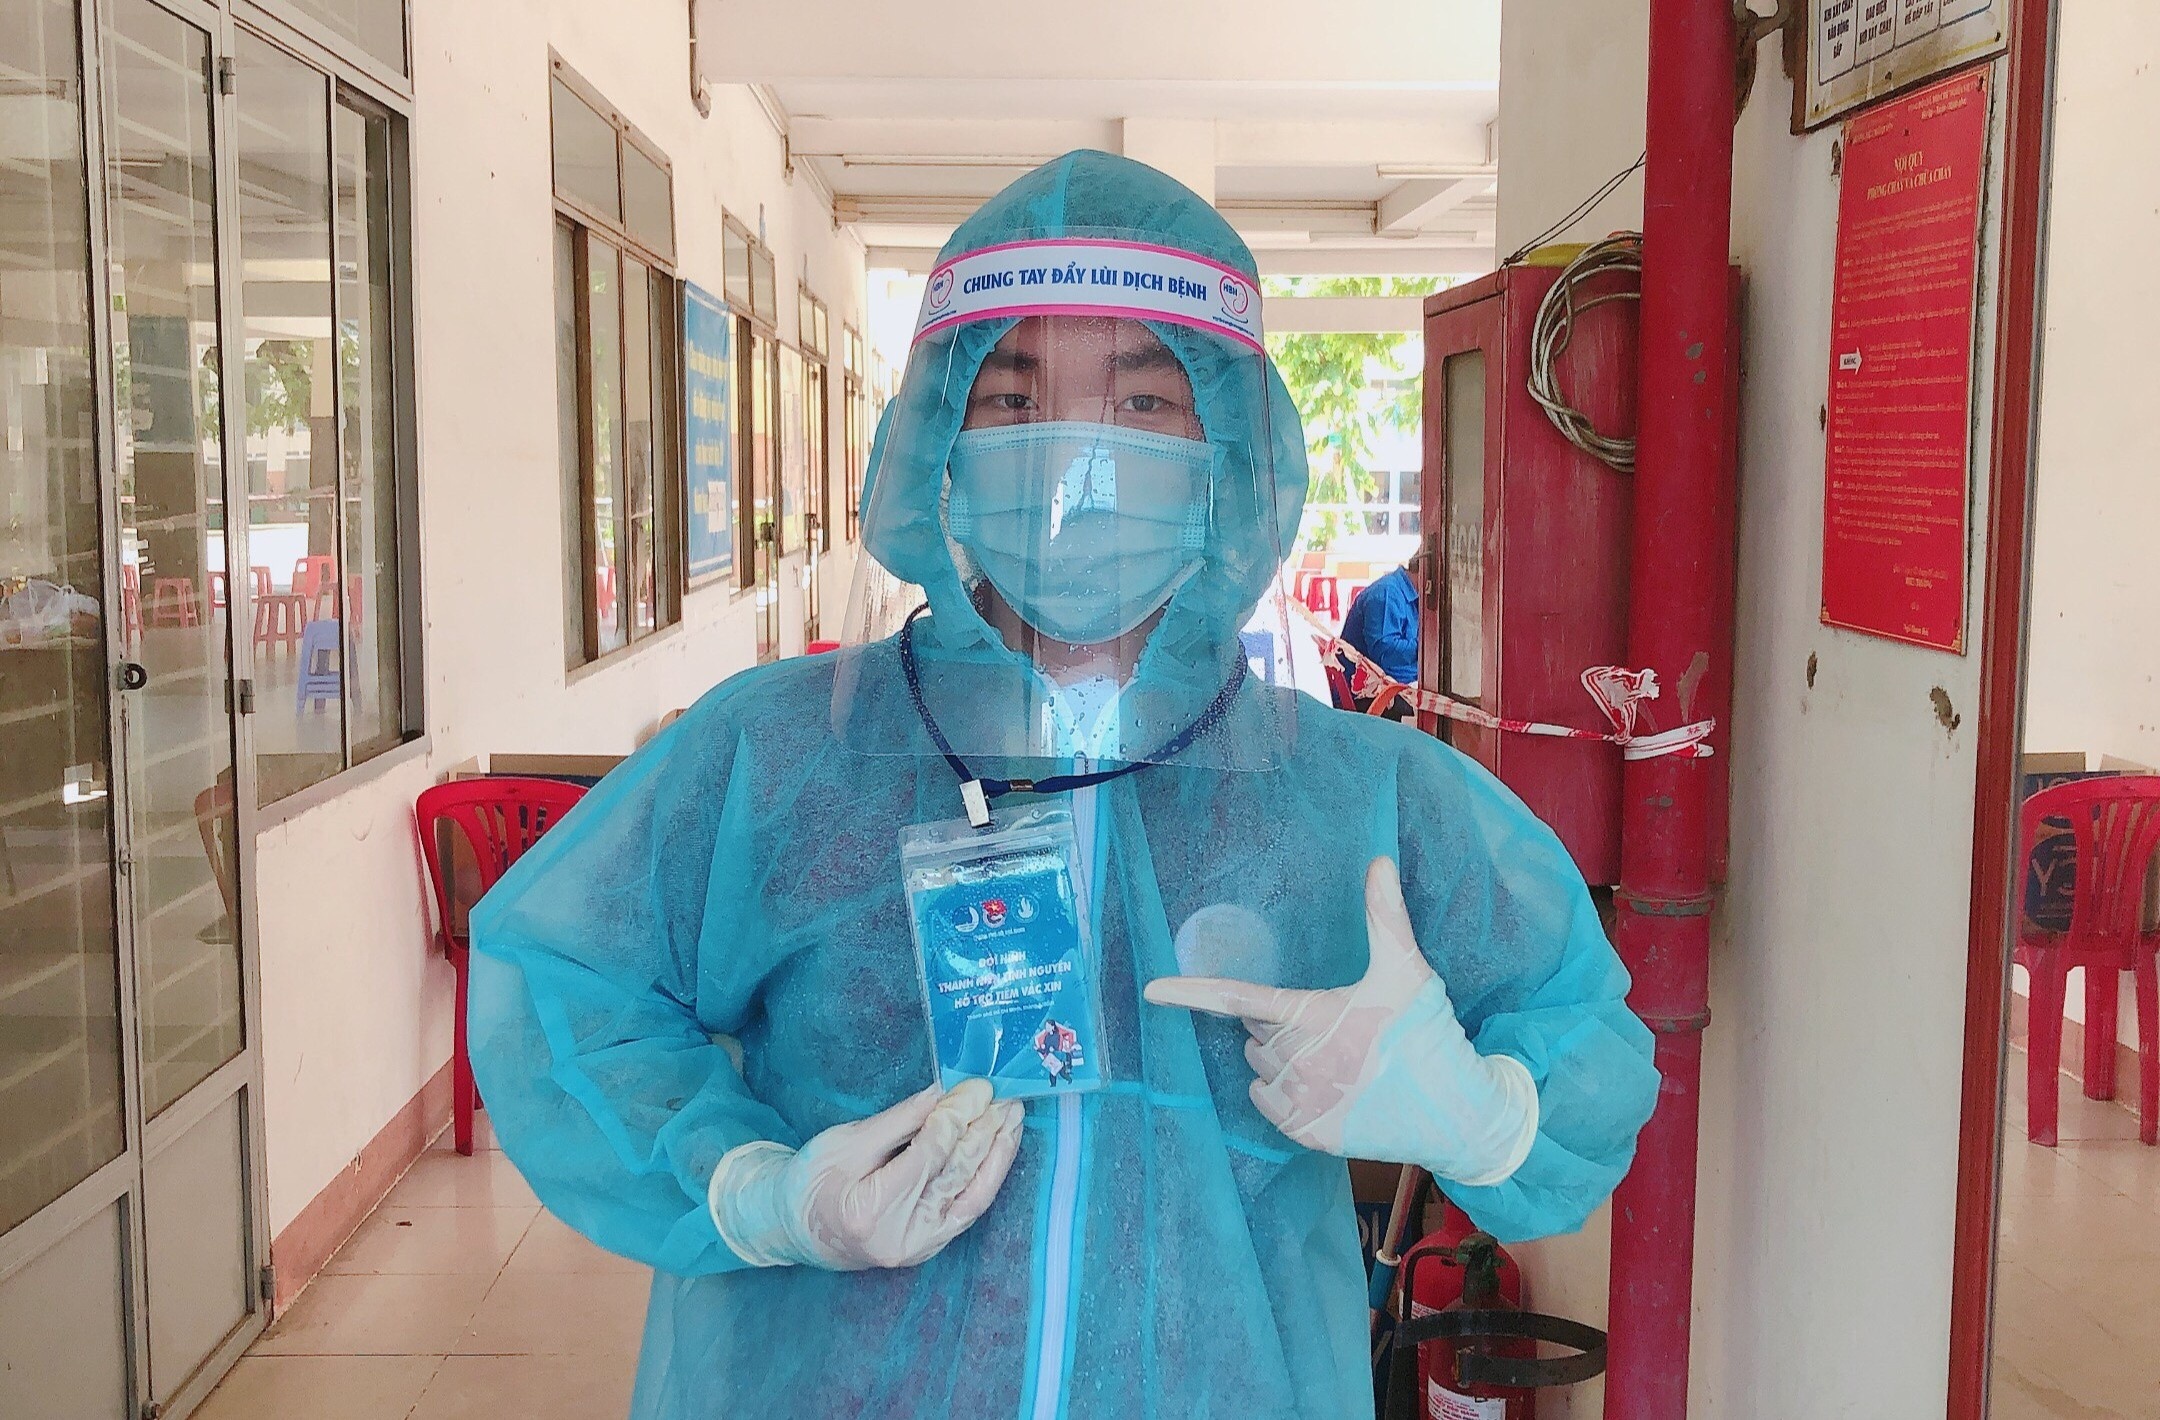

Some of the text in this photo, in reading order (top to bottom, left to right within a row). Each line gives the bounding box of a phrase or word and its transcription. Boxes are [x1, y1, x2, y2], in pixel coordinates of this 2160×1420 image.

[963, 261, 1207, 301] CHUNG TAY ĐẨY LÙI DỊCH BỆNH
[1223, 283, 1238, 297] HBN
[938, 979, 974, 993] THANH
[995, 987, 1019, 1001] TIÊM
[1043, 981, 1062, 993] XIN
